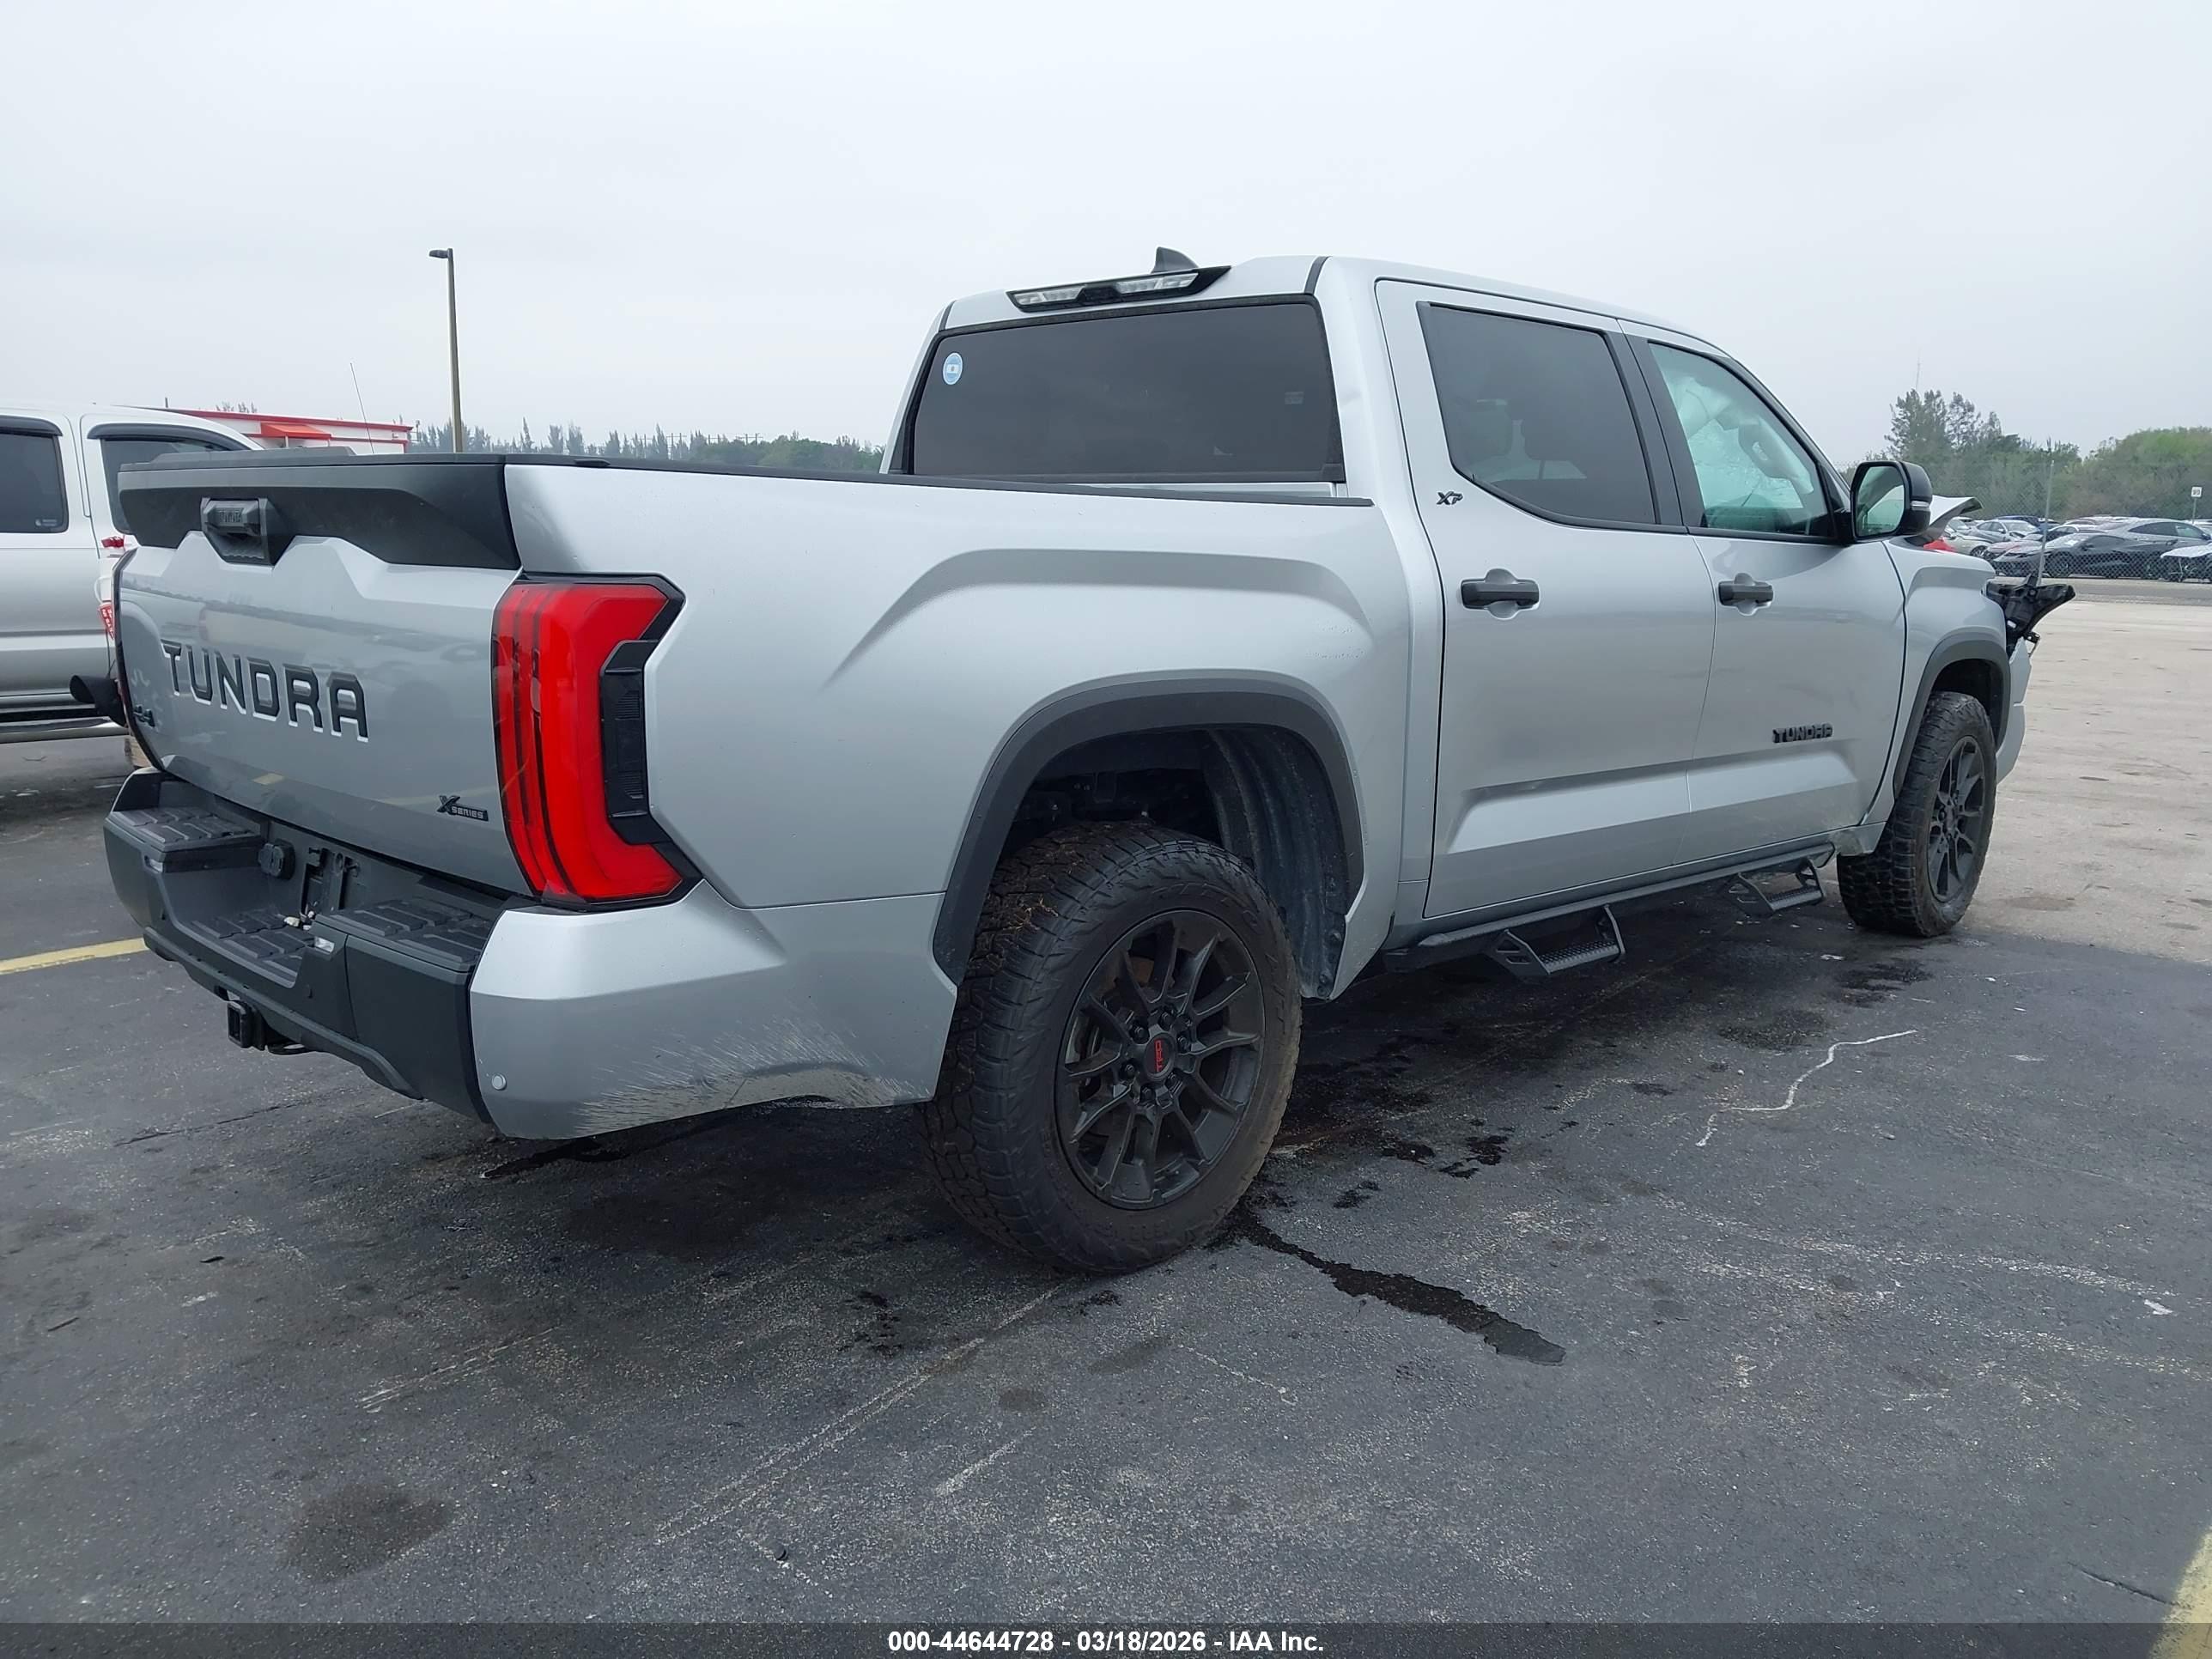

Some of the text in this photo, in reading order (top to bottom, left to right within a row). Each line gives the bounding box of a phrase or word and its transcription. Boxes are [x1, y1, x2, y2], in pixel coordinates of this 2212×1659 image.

[1436, 490, 1463, 505] XP
[161, 639, 369, 742] TUNDRA
[1772, 723, 1833, 744] TUNDRA
